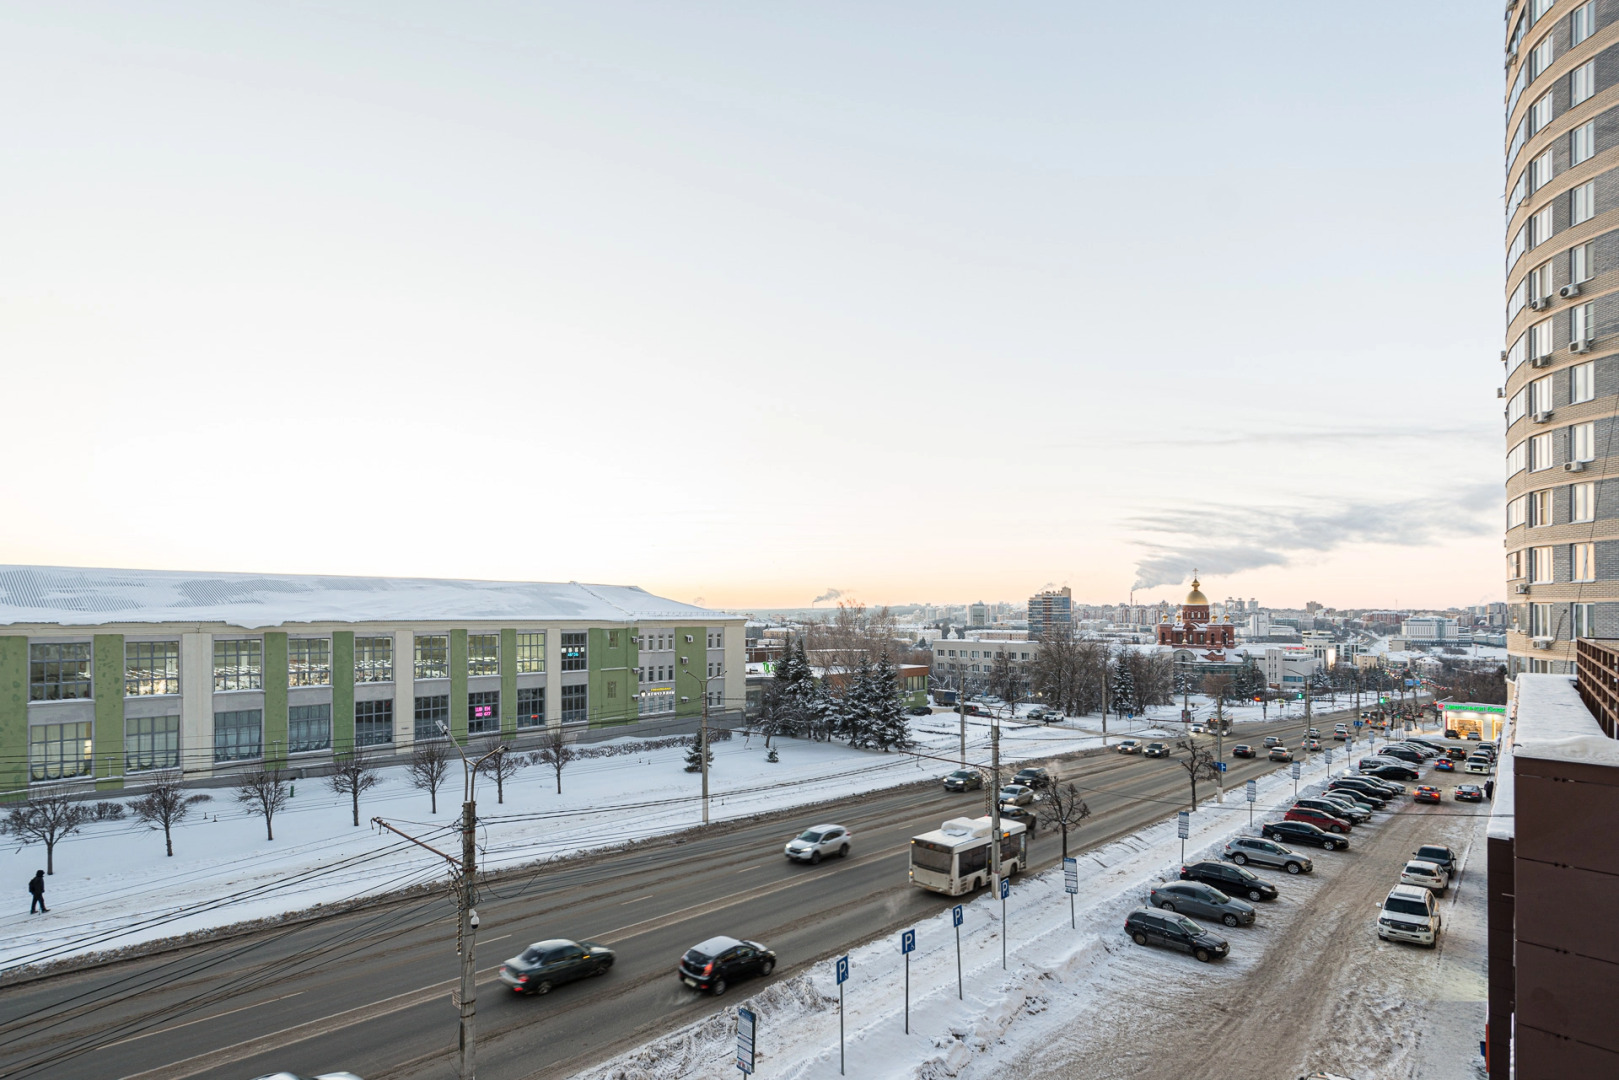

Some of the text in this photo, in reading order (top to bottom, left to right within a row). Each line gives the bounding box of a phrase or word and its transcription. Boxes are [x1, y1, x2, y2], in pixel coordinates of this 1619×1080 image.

[1002, 882, 1008, 897] P
[954, 908, 960, 924] P
[905, 933, 912, 952] P
[839, 960, 846, 981] P
